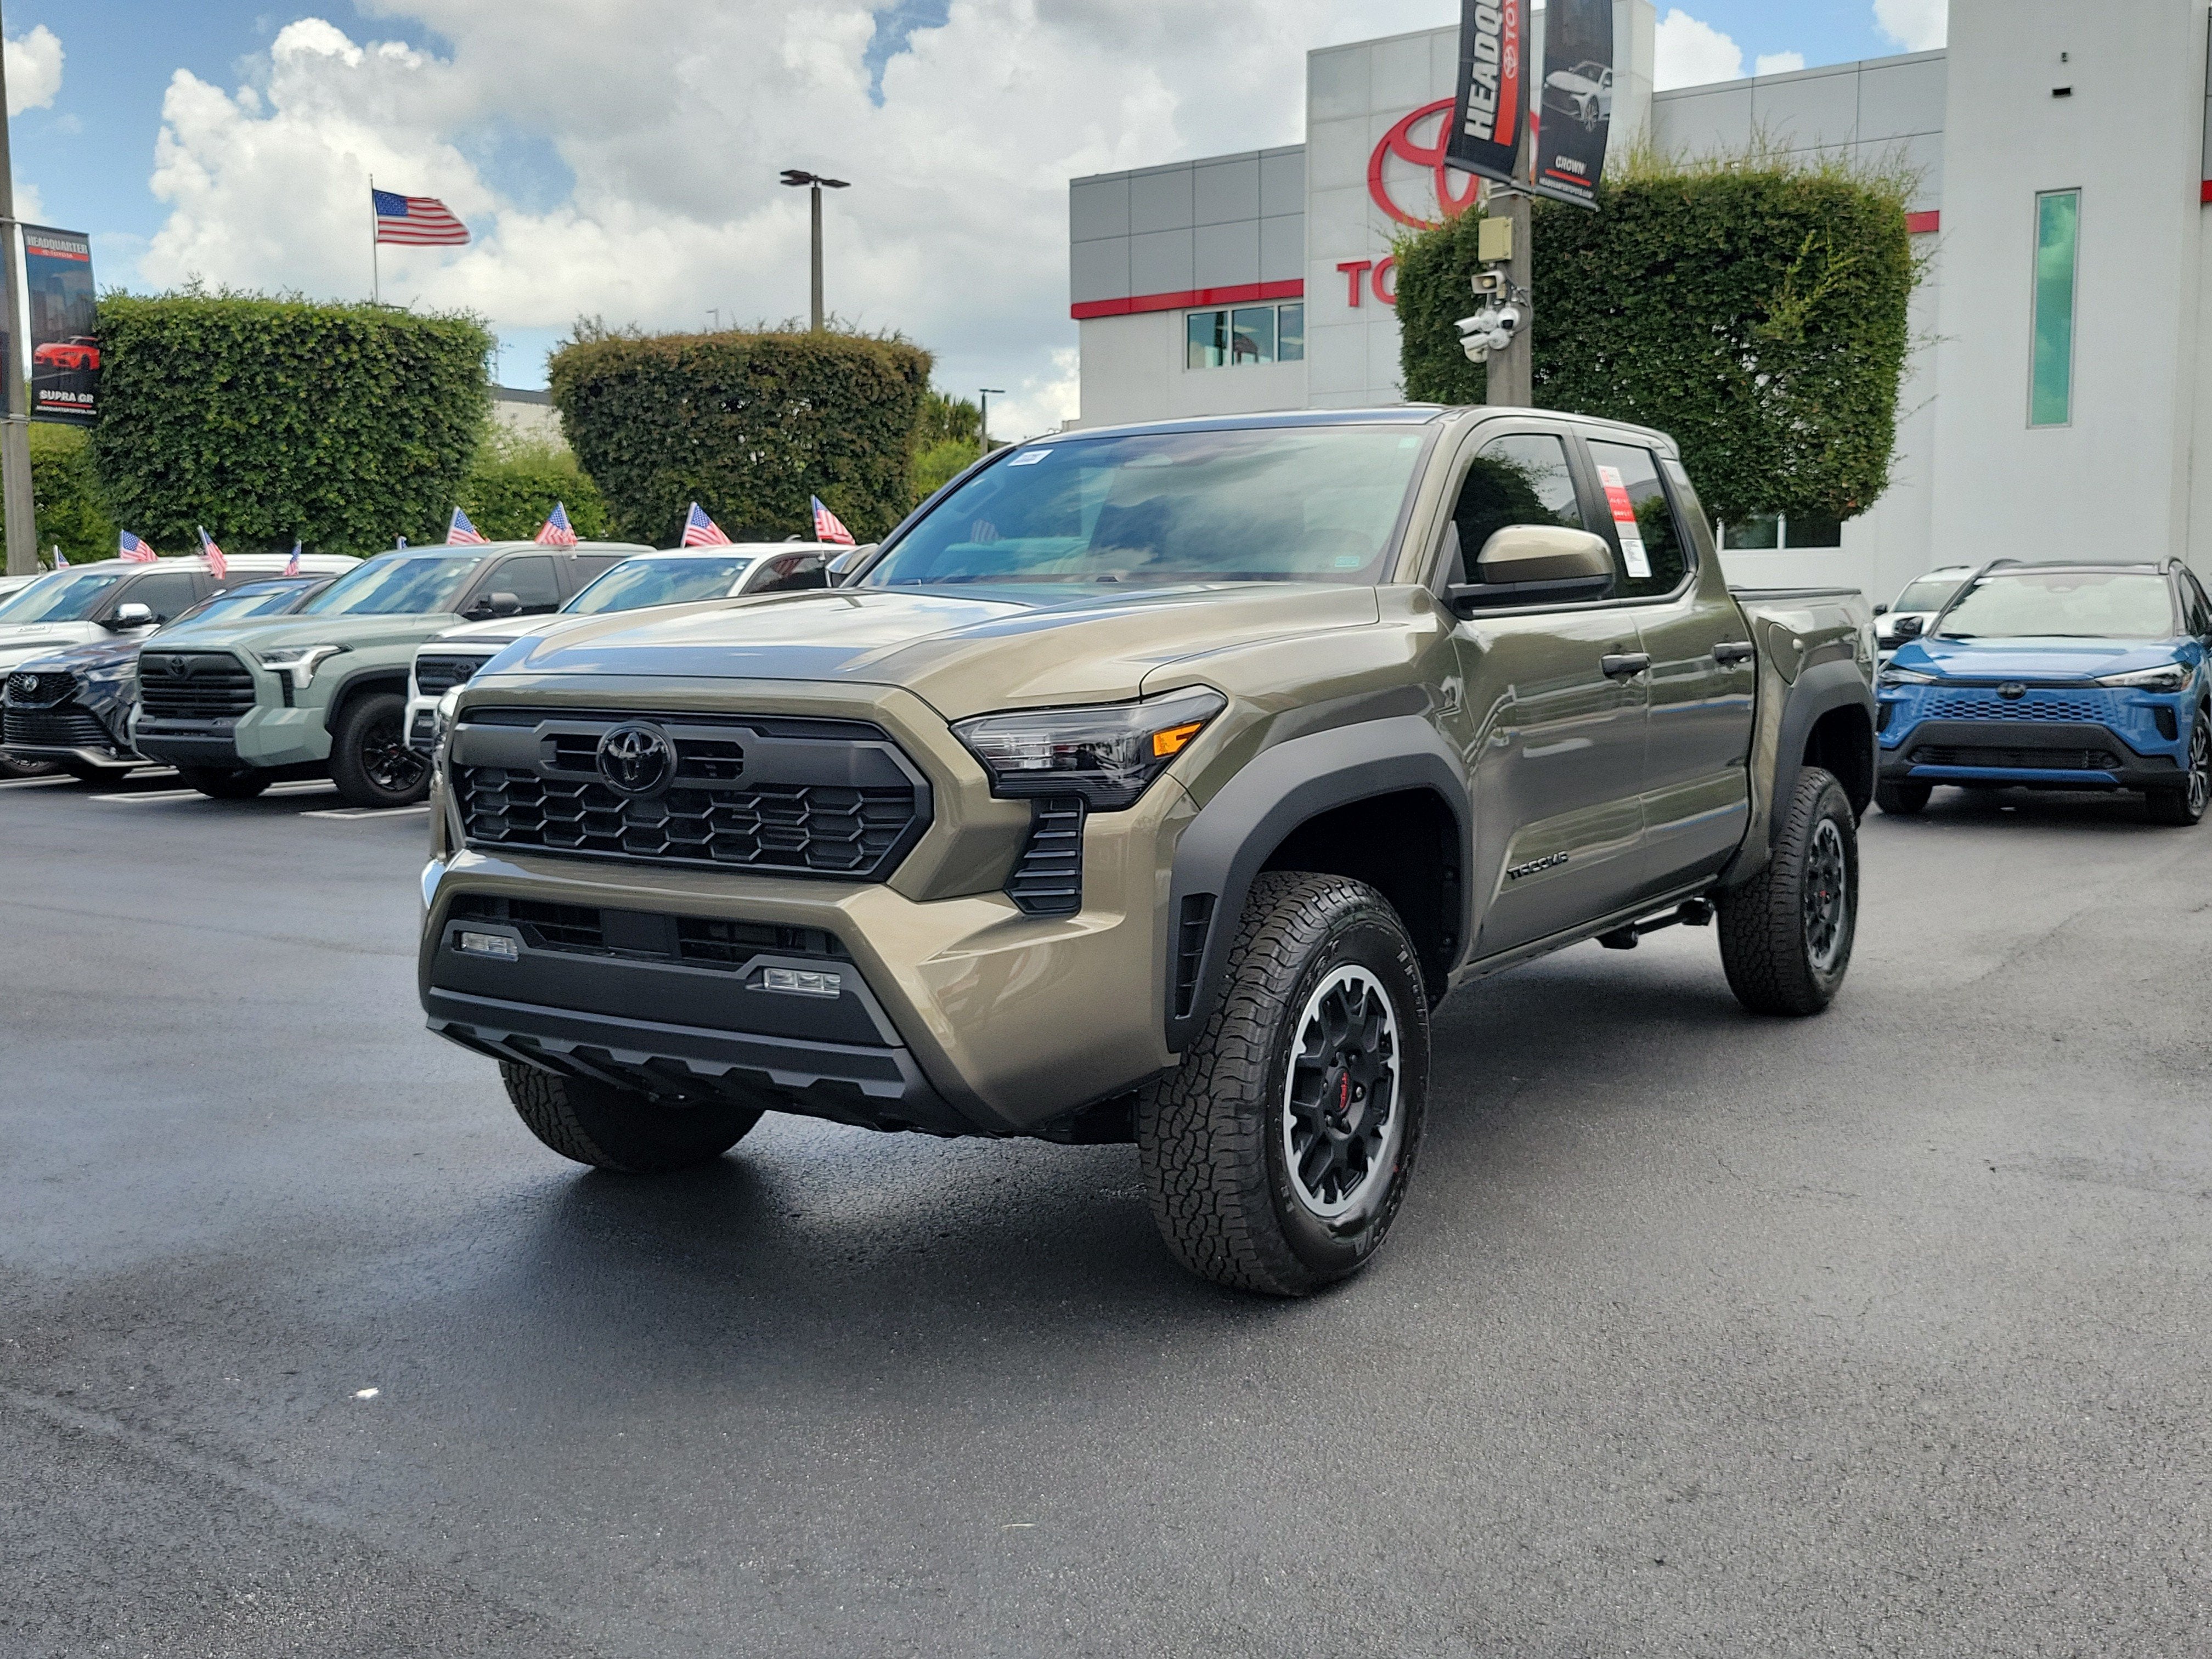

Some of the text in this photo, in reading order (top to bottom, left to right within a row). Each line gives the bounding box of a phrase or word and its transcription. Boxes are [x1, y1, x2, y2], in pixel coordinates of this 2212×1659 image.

[1555, 155, 1588, 176] CROWN
[26, 235, 88, 255] HEADQUARTER
[39, 390, 94, 403] SUPRA GR
